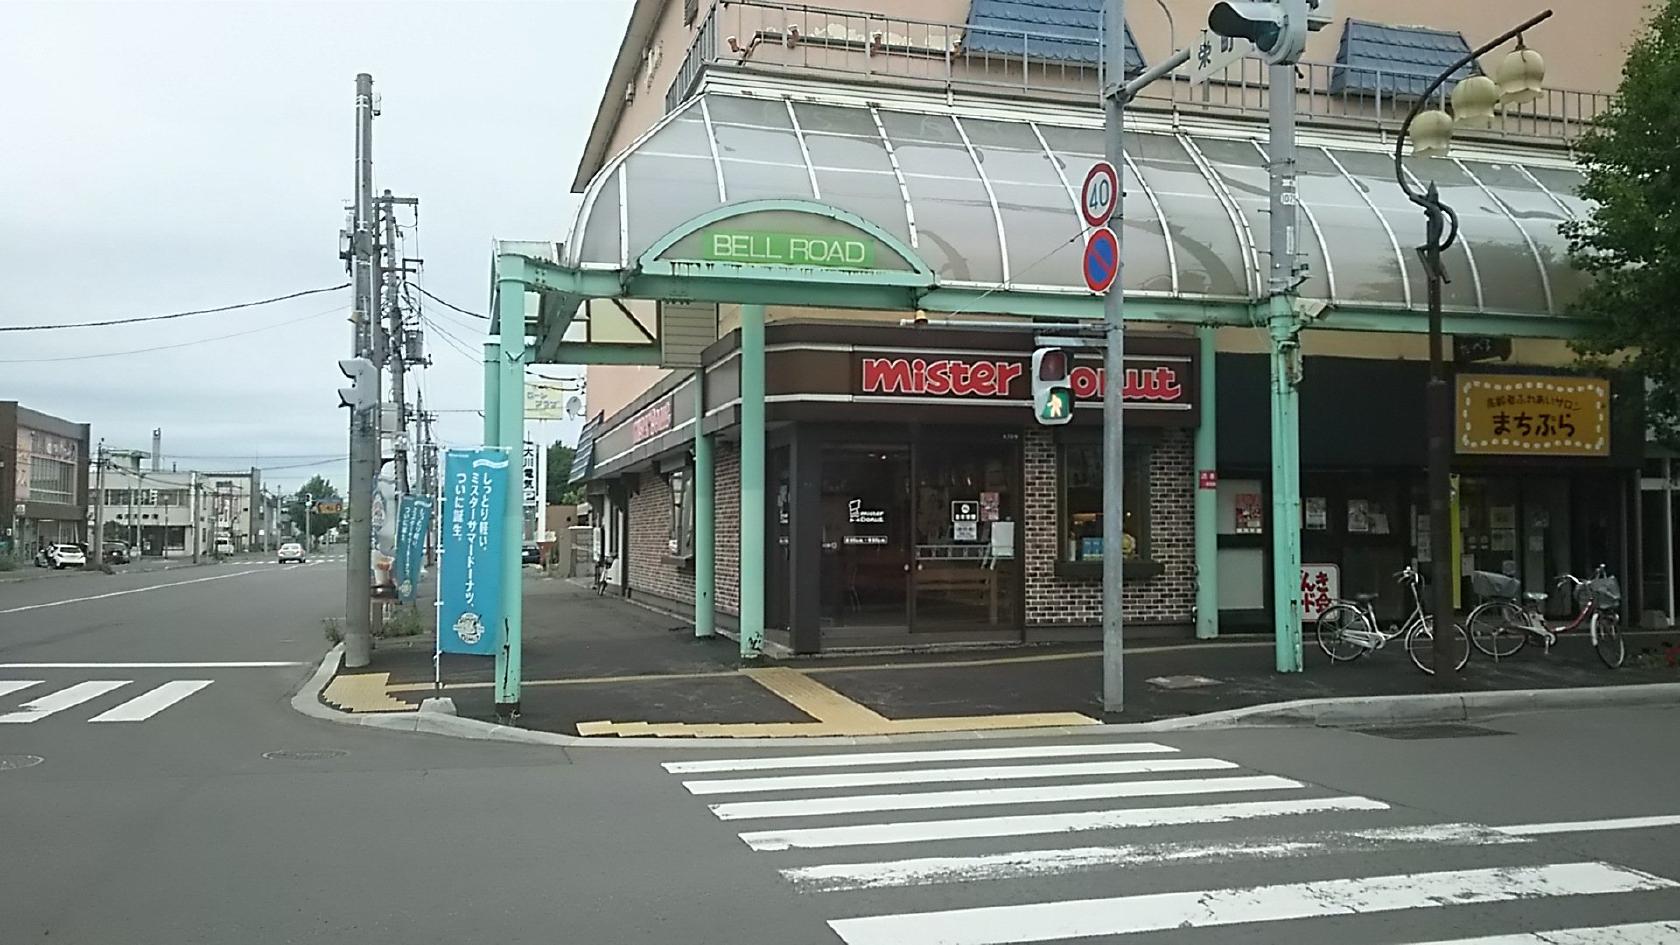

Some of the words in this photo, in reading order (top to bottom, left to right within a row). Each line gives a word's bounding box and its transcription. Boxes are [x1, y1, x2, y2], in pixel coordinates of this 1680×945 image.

[1089, 179, 1110, 209] 40
[713, 234, 782, 259] BELL
[789, 238, 865, 263] ROAD
[1300, 570, 1329, 593] んき
